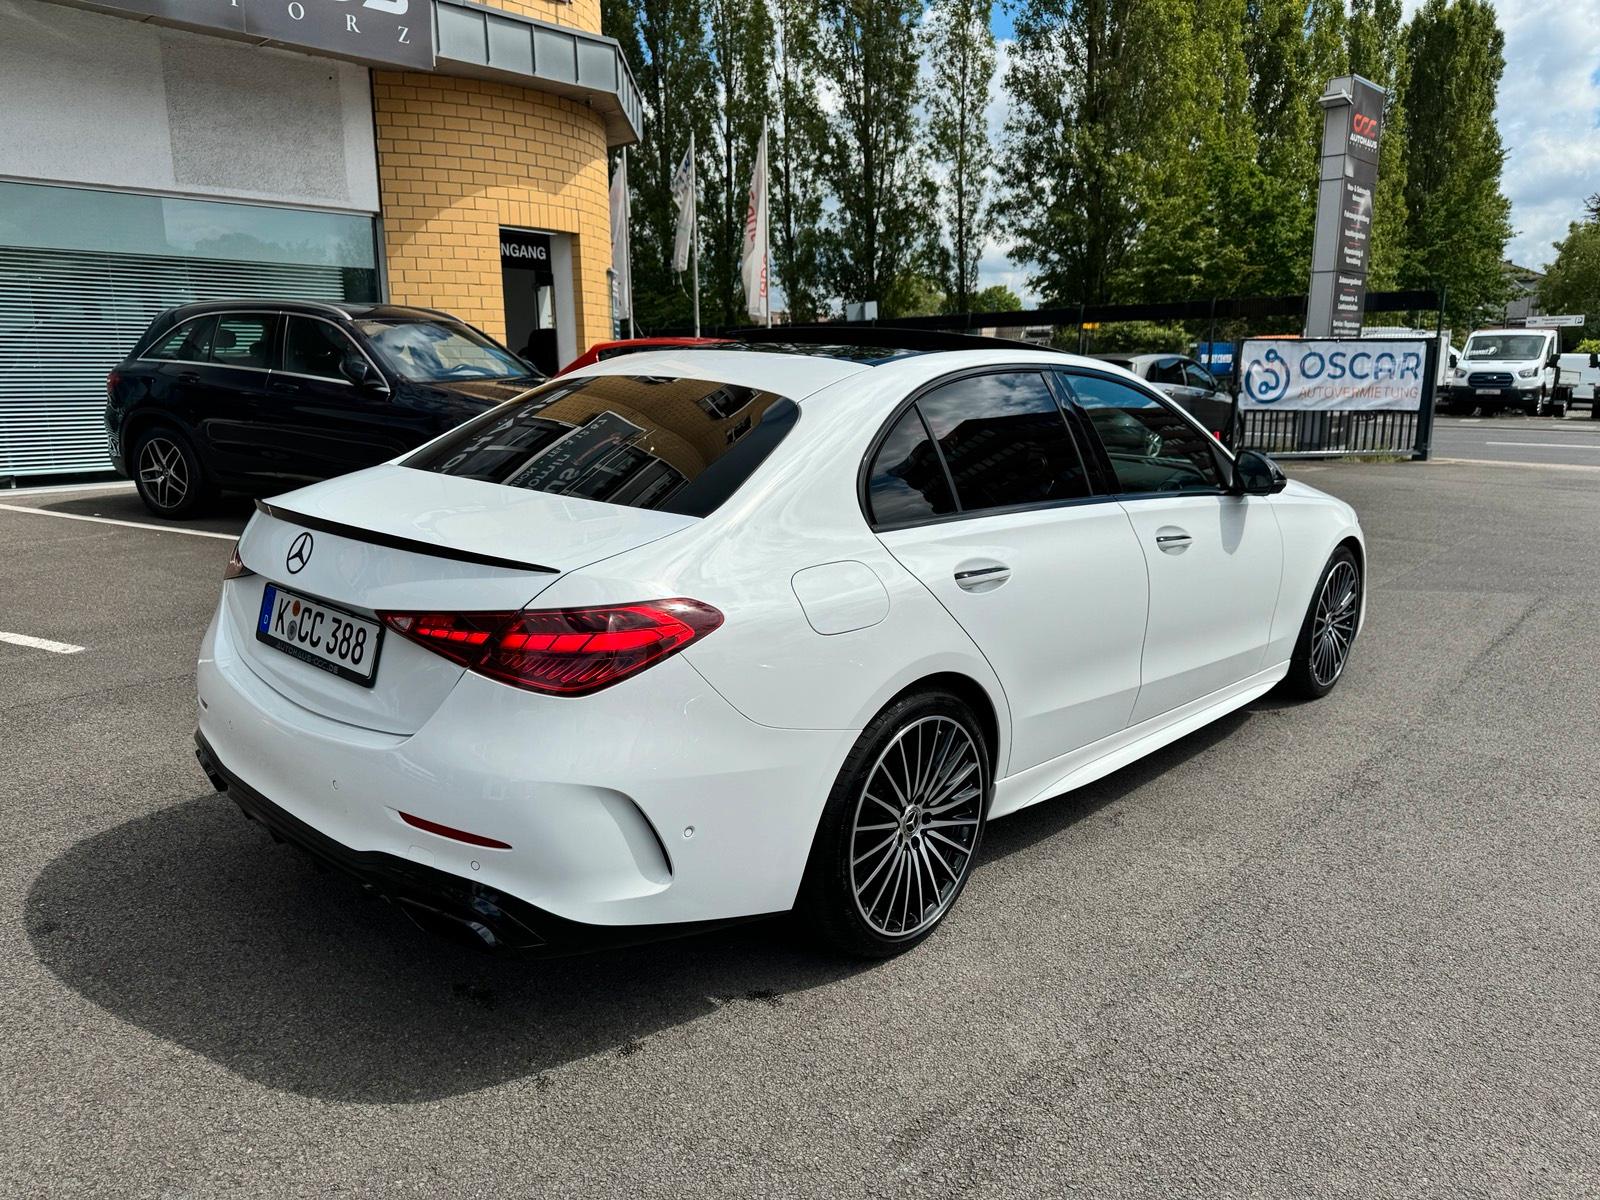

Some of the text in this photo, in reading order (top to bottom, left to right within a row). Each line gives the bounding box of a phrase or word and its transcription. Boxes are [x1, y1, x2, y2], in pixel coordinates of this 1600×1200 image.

[231, 0, 410, 44] ORZ
[500, 242, 547, 260] NGANG
[1300, 352, 1421, 380] OSCAR
[1299, 385, 1419, 400] AUTOVERMIETUNG
[298, 606, 325, 648] CC
[326, 616, 367, 665] 388
